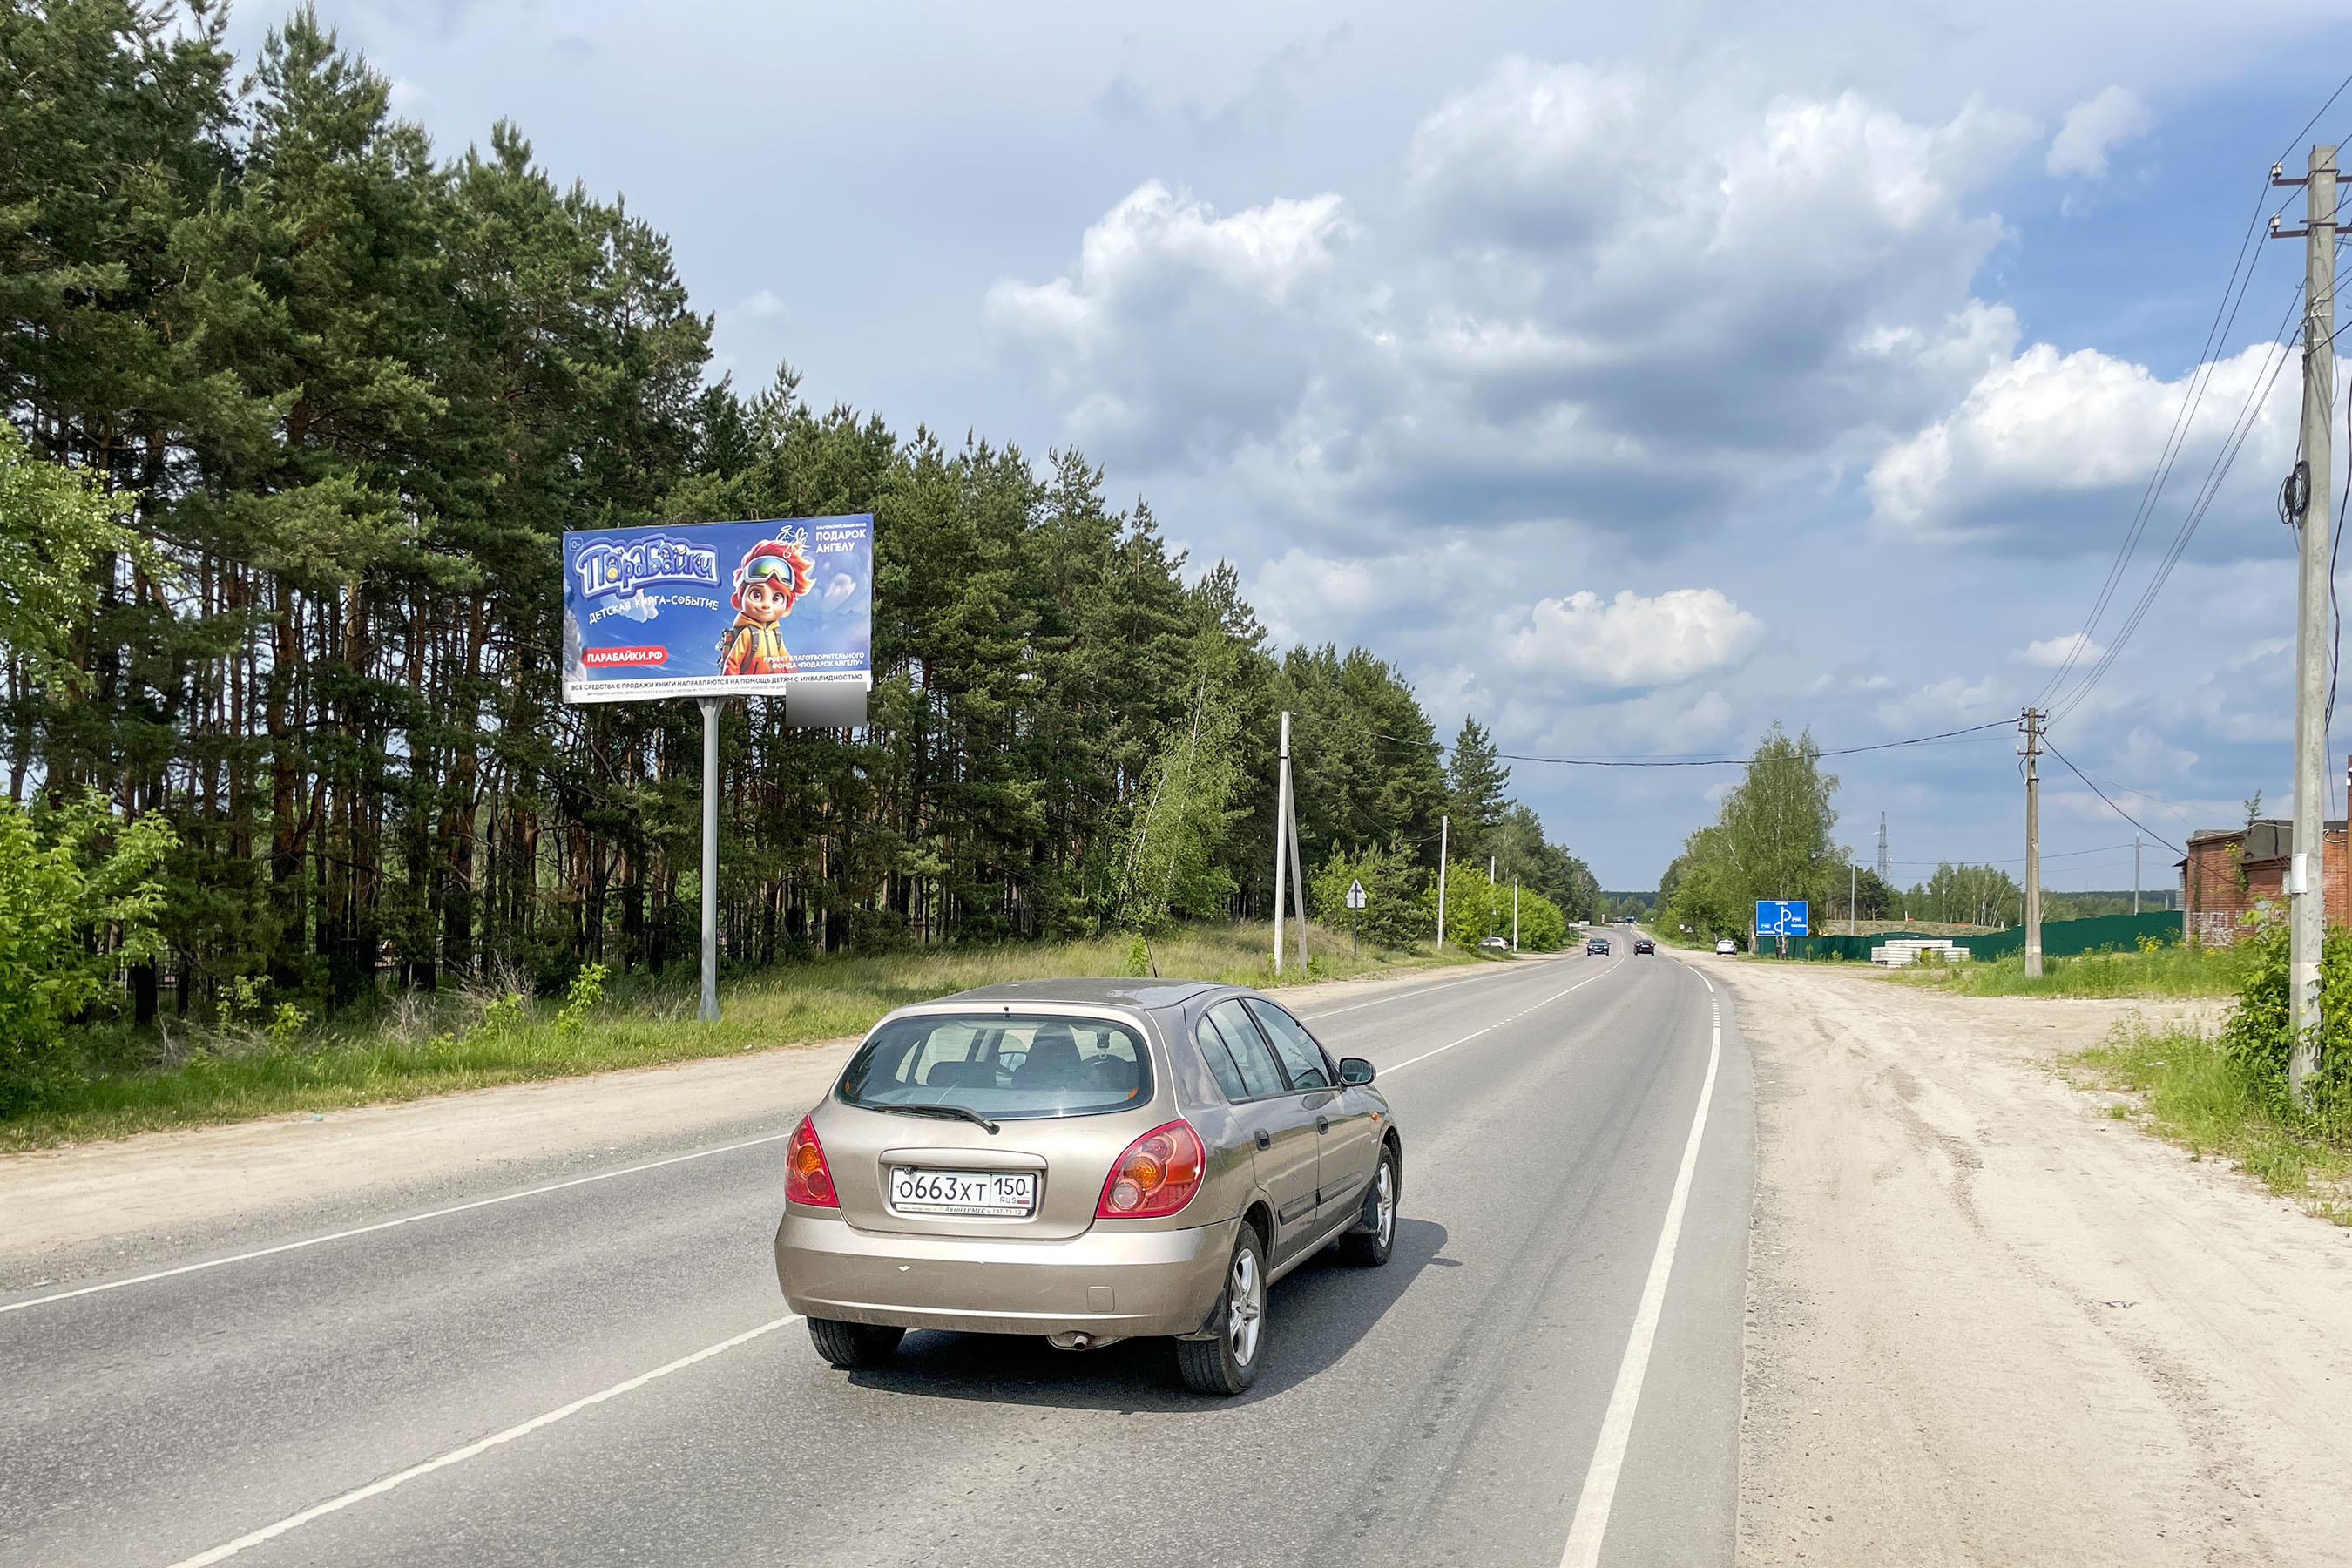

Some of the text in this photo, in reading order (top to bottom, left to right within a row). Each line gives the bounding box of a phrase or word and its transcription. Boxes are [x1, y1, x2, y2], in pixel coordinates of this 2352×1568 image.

[815, 529, 867, 542] ПОДАРОК
[815, 542, 855, 553] АНГЕЛУ
[589, 595, 720, 625] ДЕТСКАЯ КНИГА-СОБЫТИЕ
[586, 650, 664, 663] ПАРАБАЙКИ.РФ
[789, 652, 865, 662] БЛАГОТВОРИТЕЛЬНОГО
[993, 1177, 1026, 1196] 150
